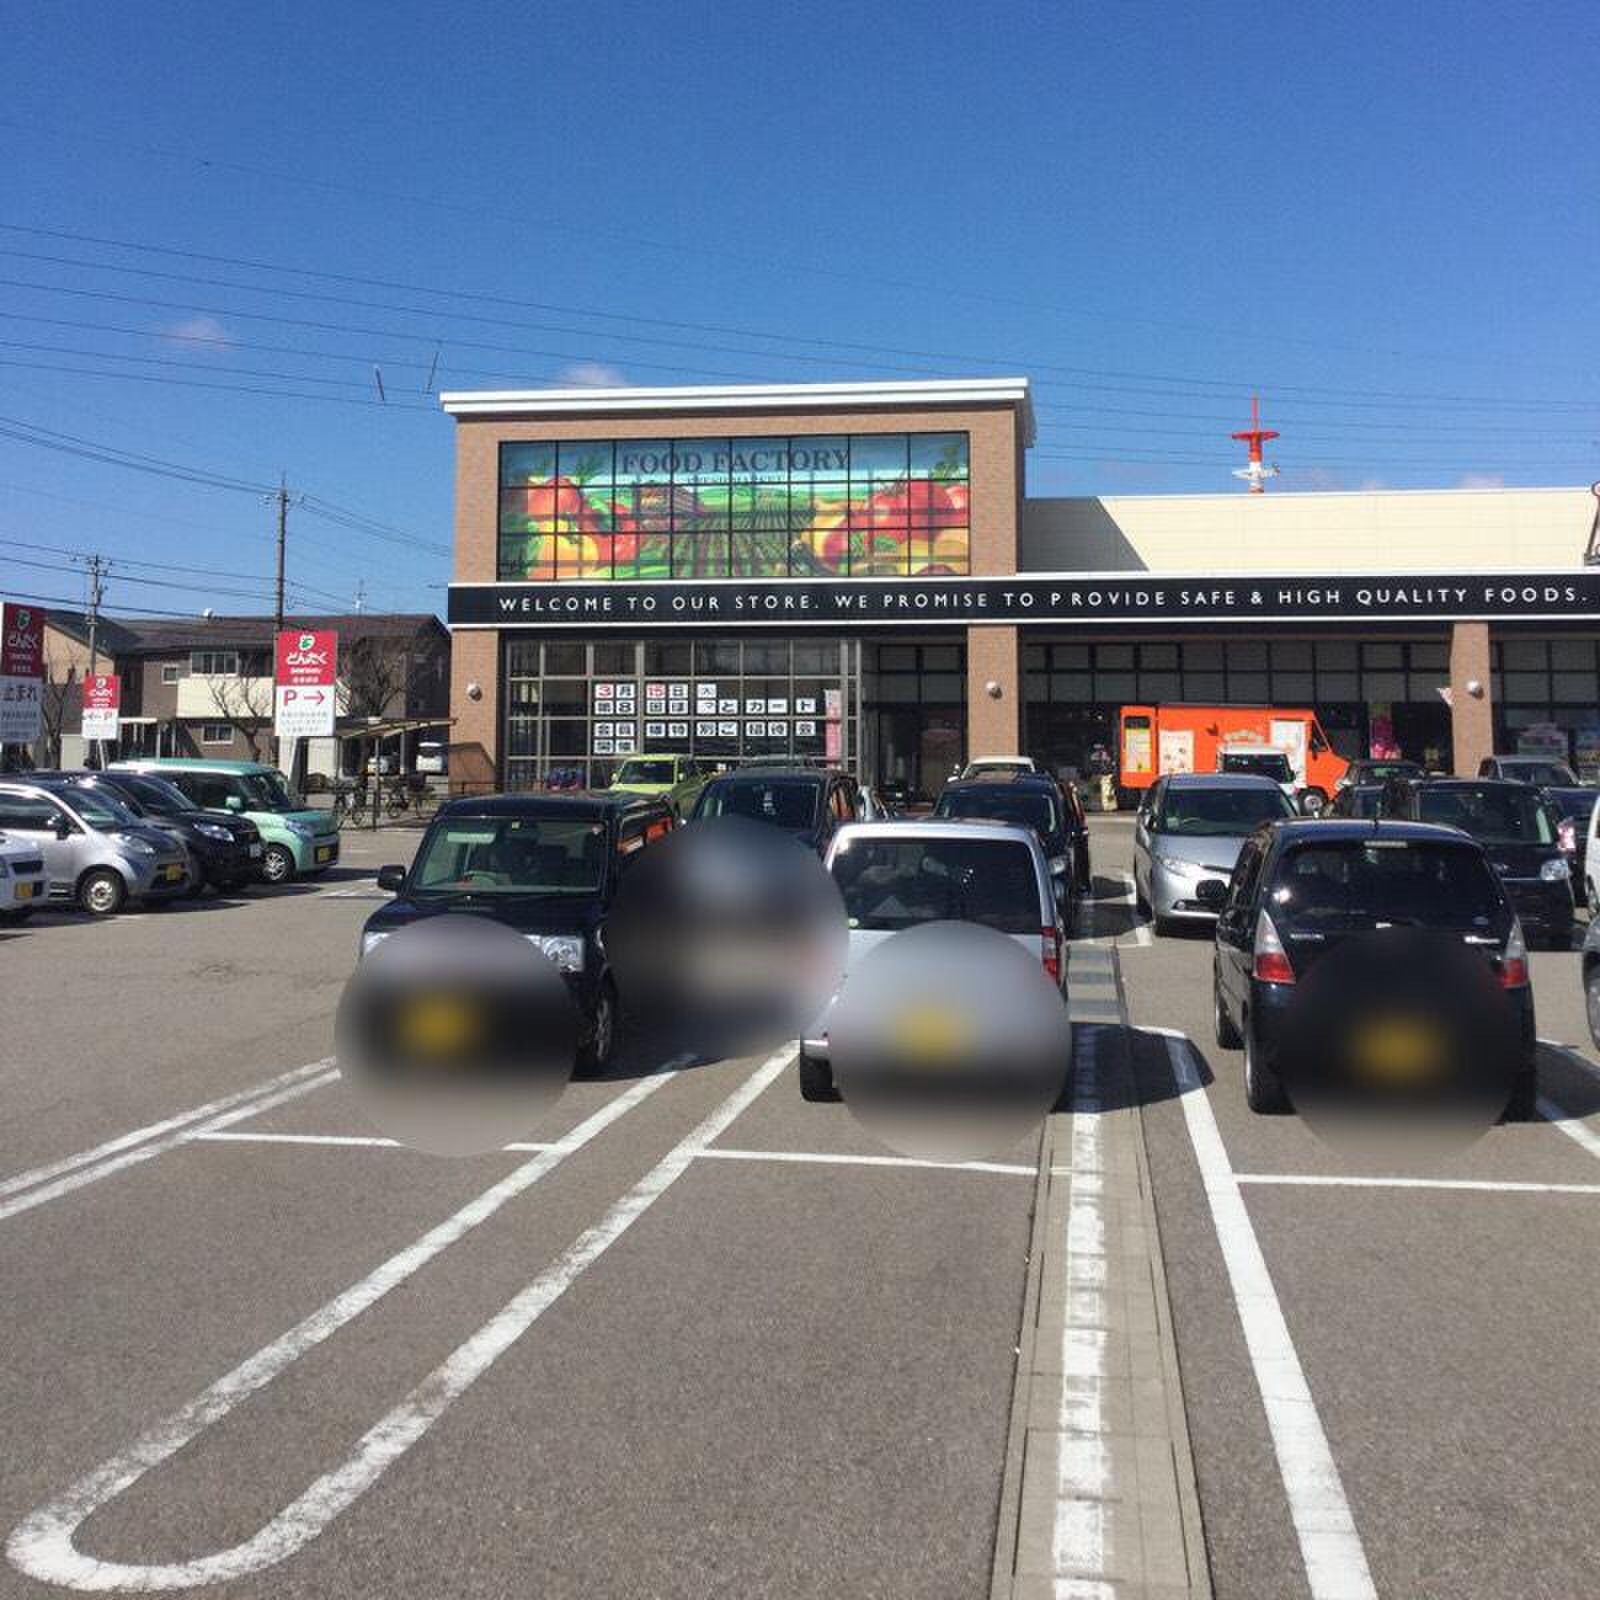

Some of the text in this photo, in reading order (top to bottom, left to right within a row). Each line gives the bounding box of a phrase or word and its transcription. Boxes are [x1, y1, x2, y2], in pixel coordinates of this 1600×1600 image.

[622, 448, 850, 476] FOOD FACTORY
[499, 587, 1587, 612] WELCOME TO OUR STORE. WE PROMISE TO PROVIDE SAFE & HIGH QUALITY FOODS.
[283, 689, 298, 706] P
